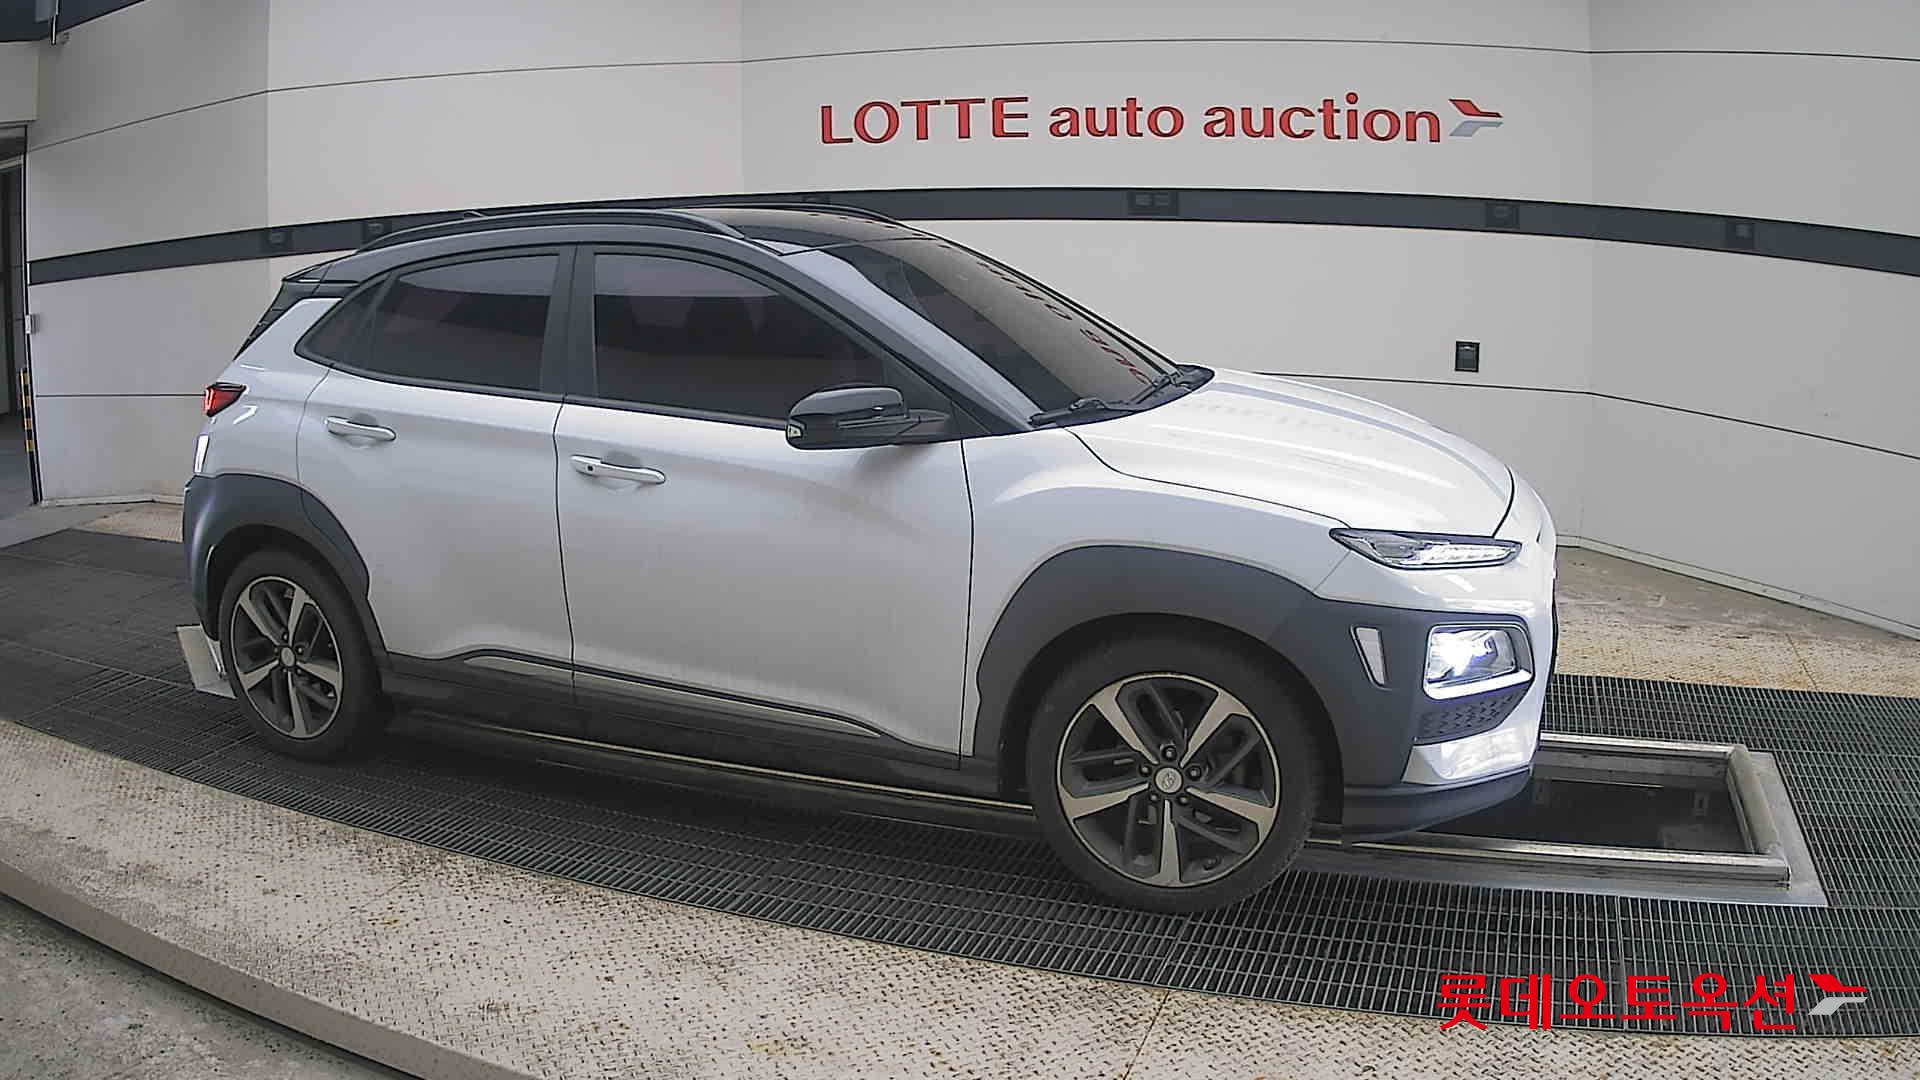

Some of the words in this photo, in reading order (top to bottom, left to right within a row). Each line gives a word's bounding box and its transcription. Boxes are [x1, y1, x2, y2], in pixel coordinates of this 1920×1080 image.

[820, 97, 1029, 144] LOTTE
[1049, 97, 1185, 138] auto
[1203, 92, 1441, 143] auction
